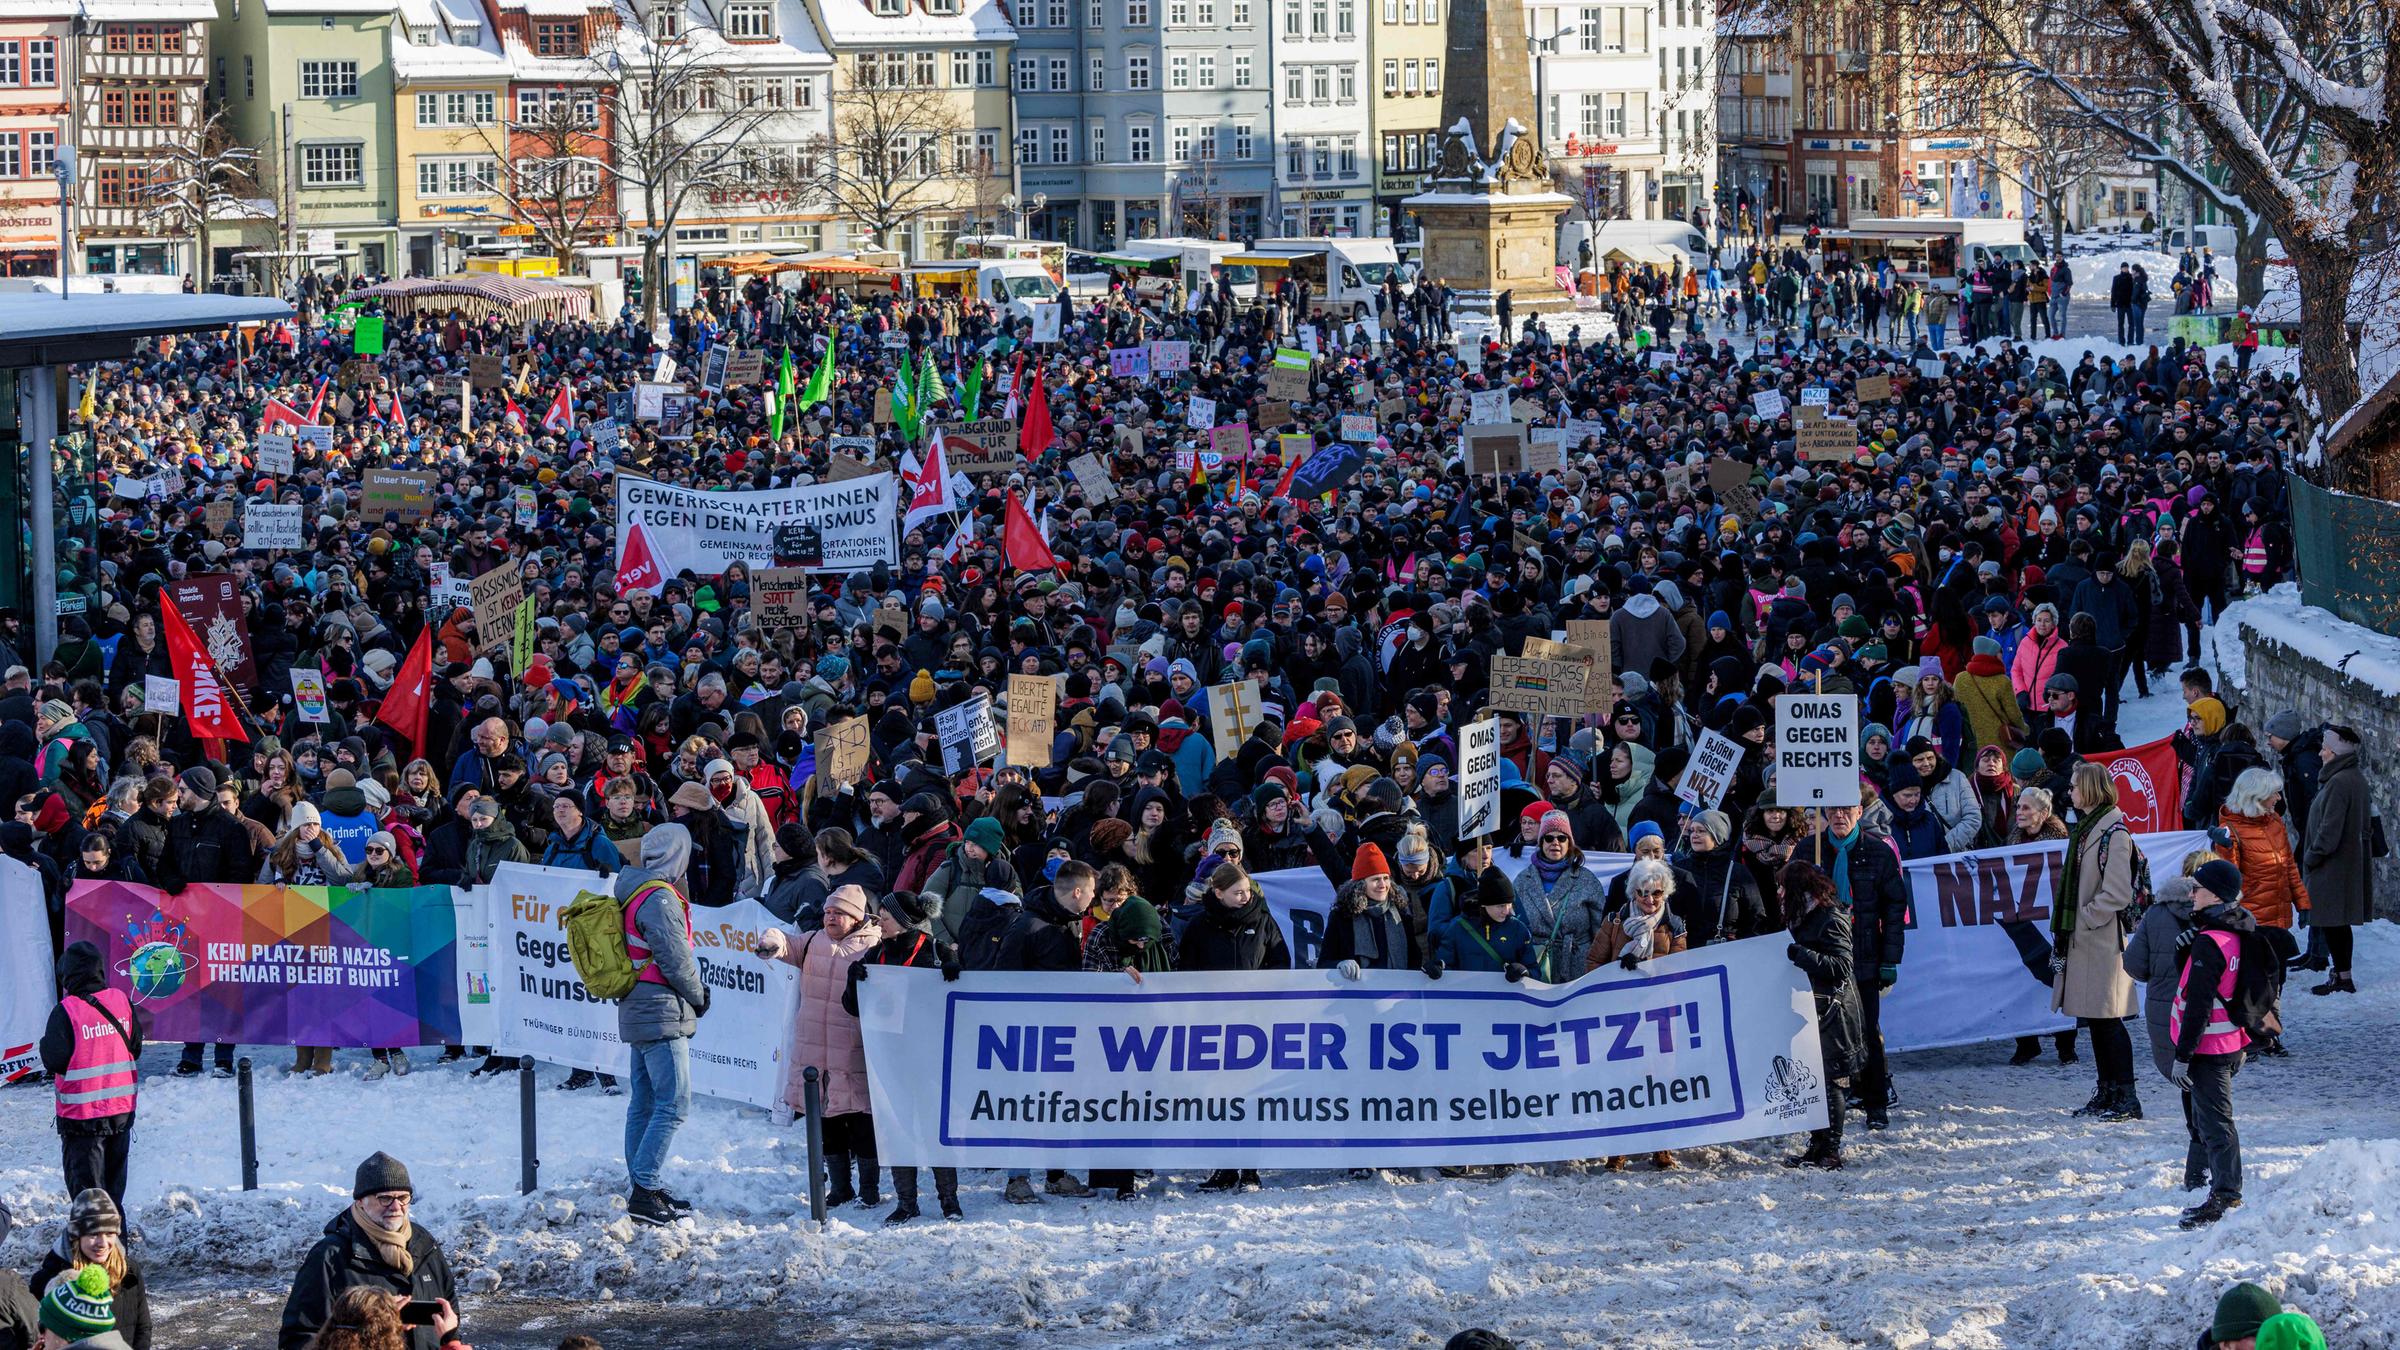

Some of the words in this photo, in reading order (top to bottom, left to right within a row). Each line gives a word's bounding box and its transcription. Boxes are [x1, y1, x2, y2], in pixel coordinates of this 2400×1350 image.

[1300, 189, 1345, 201] ANTIQUARIAT
[1803, 388, 1827, 398] NAZIS
[979, 434, 1006, 449] FÜR
[945, 451, 1015, 466] EUTSCHLAND
[373, 475, 398, 485] Unser
[401, 475, 426, 486] Traum
[367, 505, 383, 515] und
[385, 506, 406, 516] nicht
[705, 515, 748, 534] DEN
[700, 539, 764, 551] GEMEINSAM
[821, 536, 886, 550] ORTATIONEN
[722, 551, 746, 561] UND
[822, 546, 887, 561] RZFANTASIEN
[472, 567, 520, 607] RASSISMUS
[61, 599, 85, 613] Parken
[179, 593, 204, 602] Petersberg
[484, 602, 498, 619] IST
[501, 588, 523, 613] KEINE
[763, 592, 795, 604] STATT
[765, 604, 788, 615] rechte
[757, 613, 802, 627] Menschen
[1492, 656, 1526, 674] LEBE
[1529, 660, 1549, 678] SO,
[1551, 662, 1585, 681] DASS
[1012, 680, 1049, 698] LIBERTÉ
[1491, 673, 1512, 689] DIE
[1515, 676, 1547, 690] AFD
[1549, 679, 1584, 694] ETWAS
[1011, 698, 1047, 717] EGALITÉ
[1490, 690, 1548, 712] DAGEGEN
[1550, 695, 1585, 715] HÄTTE
[1790, 702, 1842, 719] OMAS
[938, 710, 958, 725] #say
[968, 714, 986, 729] ent-
[940, 722, 958, 738] their
[942, 727, 968, 747] names
[970, 722, 994, 741] waff-
[1470, 727, 1495, 749] OMAS
[1786, 726, 1848, 744] GEGEN
[973, 734, 994, 750] nen!
[1705, 736, 1736, 762] BJÖRN
[1467, 750, 1496, 775] GEGEN
[1698, 751, 1729, 776] HÖCKE
[1782, 750, 1853, 769] RECHTS
[1464, 777, 1499, 801] RECHTS
[1687, 769, 1721, 801] NAZI
[511, 894, 549, 924] Für
[207, 942, 246, 962] KEIN
[251, 943, 305, 964] PLATZ
[343, 947, 391, 967] NAZIS
[515, 931, 572, 968] Gege
[699, 956, 766, 995] Rassisten
[207, 963, 281, 984] THEMAR
[286, 964, 343, 986] BLEIBT
[348, 967, 400, 988] BUNT!
[519, 966, 538, 993] in
[522, 1017, 564, 1036] THÜRINGER
[733, 1056, 759, 1071] RECHTS
[976, 1024, 1077, 1073] NIE
[1098, 1022, 1349, 1073] WIEDER
[1369, 1022, 1461, 1072] IST
[1482, 1001, 1702, 1071] JETZT!
[970, 1089, 1246, 1123] Antifaschismus
[1257, 1097, 1350, 1122] muss
[1361, 1094, 1448, 1122] man
[1449, 1088, 1560, 1122] selber
[1571, 1073, 1711, 1115] machen
[1764, 1106, 1779, 1117] AUF
[1780, 1102, 1792, 1113] DIE
[1778, 1106, 1808, 1121] FERTIG!
[66, 1298, 110, 1318] RALLY
